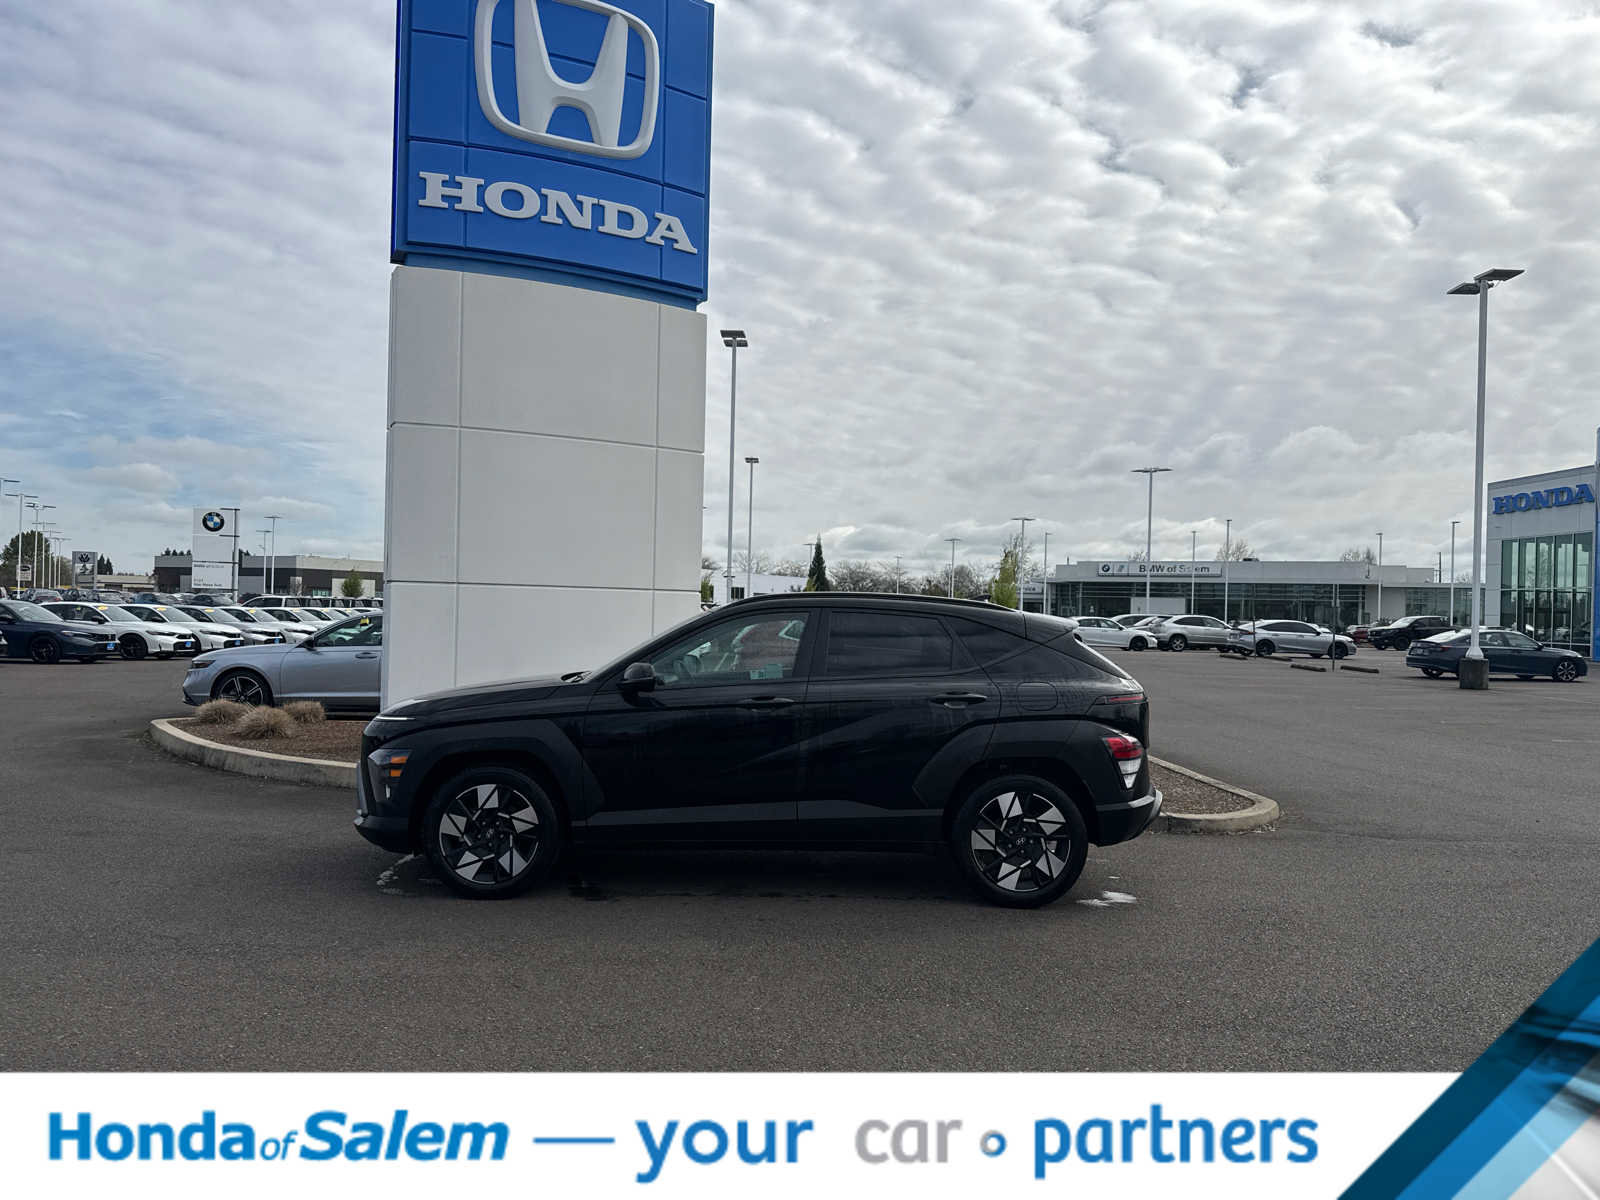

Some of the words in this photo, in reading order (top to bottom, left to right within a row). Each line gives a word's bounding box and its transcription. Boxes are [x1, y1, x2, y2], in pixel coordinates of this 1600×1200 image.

[418, 171, 698, 254] HONDA
[1492, 483, 1595, 515] HONDA
[1138, 564, 1165, 573] BMW
[1167, 564, 1178, 573] of
